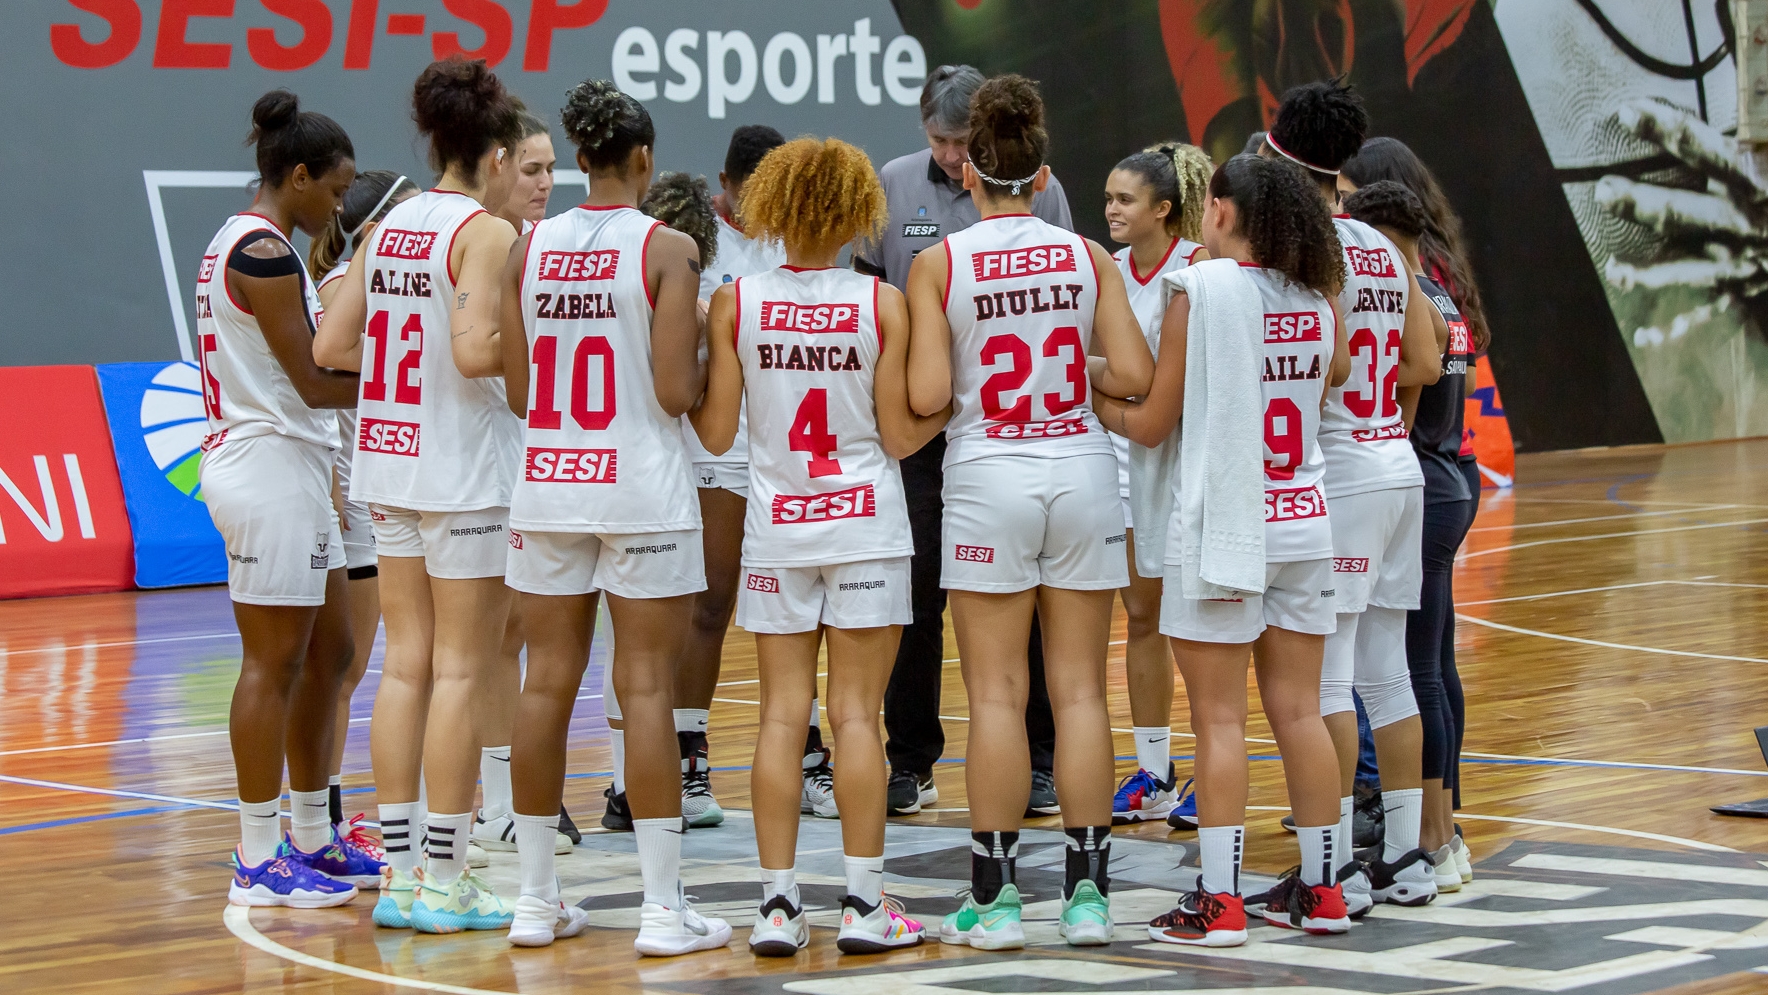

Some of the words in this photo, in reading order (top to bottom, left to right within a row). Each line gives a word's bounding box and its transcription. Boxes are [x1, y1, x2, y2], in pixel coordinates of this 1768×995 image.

[611, 17, 927, 119] esporte
[380, 232, 430, 257] FIESP
[904, 225, 938, 236] FIESP
[543, 253, 613, 278] FIESP
[982, 247, 1068, 277] FIESP
[370, 268, 432, 298] ALINE
[535, 292, 617, 320] ZABELA
[973, 284, 1083, 321] DIULLY
[768, 304, 852, 331] FIESP
[363, 309, 424, 406] 12
[757, 343, 862, 372] BIANCA
[528, 335, 617, 431] 10
[980, 326, 1087, 422] 23
[1343, 327, 1401, 419] 32
[788, 387, 843, 479] 4
[1263, 397, 1304, 481] 9
[530, 451, 611, 480] SESI
[779, 489, 866, 522] SESI
[450, 524, 503, 537] ARARAQUARA
[625, 543, 677, 555] ARARAQUARA
[956, 546, 991, 562] SESI
[1334, 558, 1367, 572] SESI
[749, 576, 778, 592] SESI
